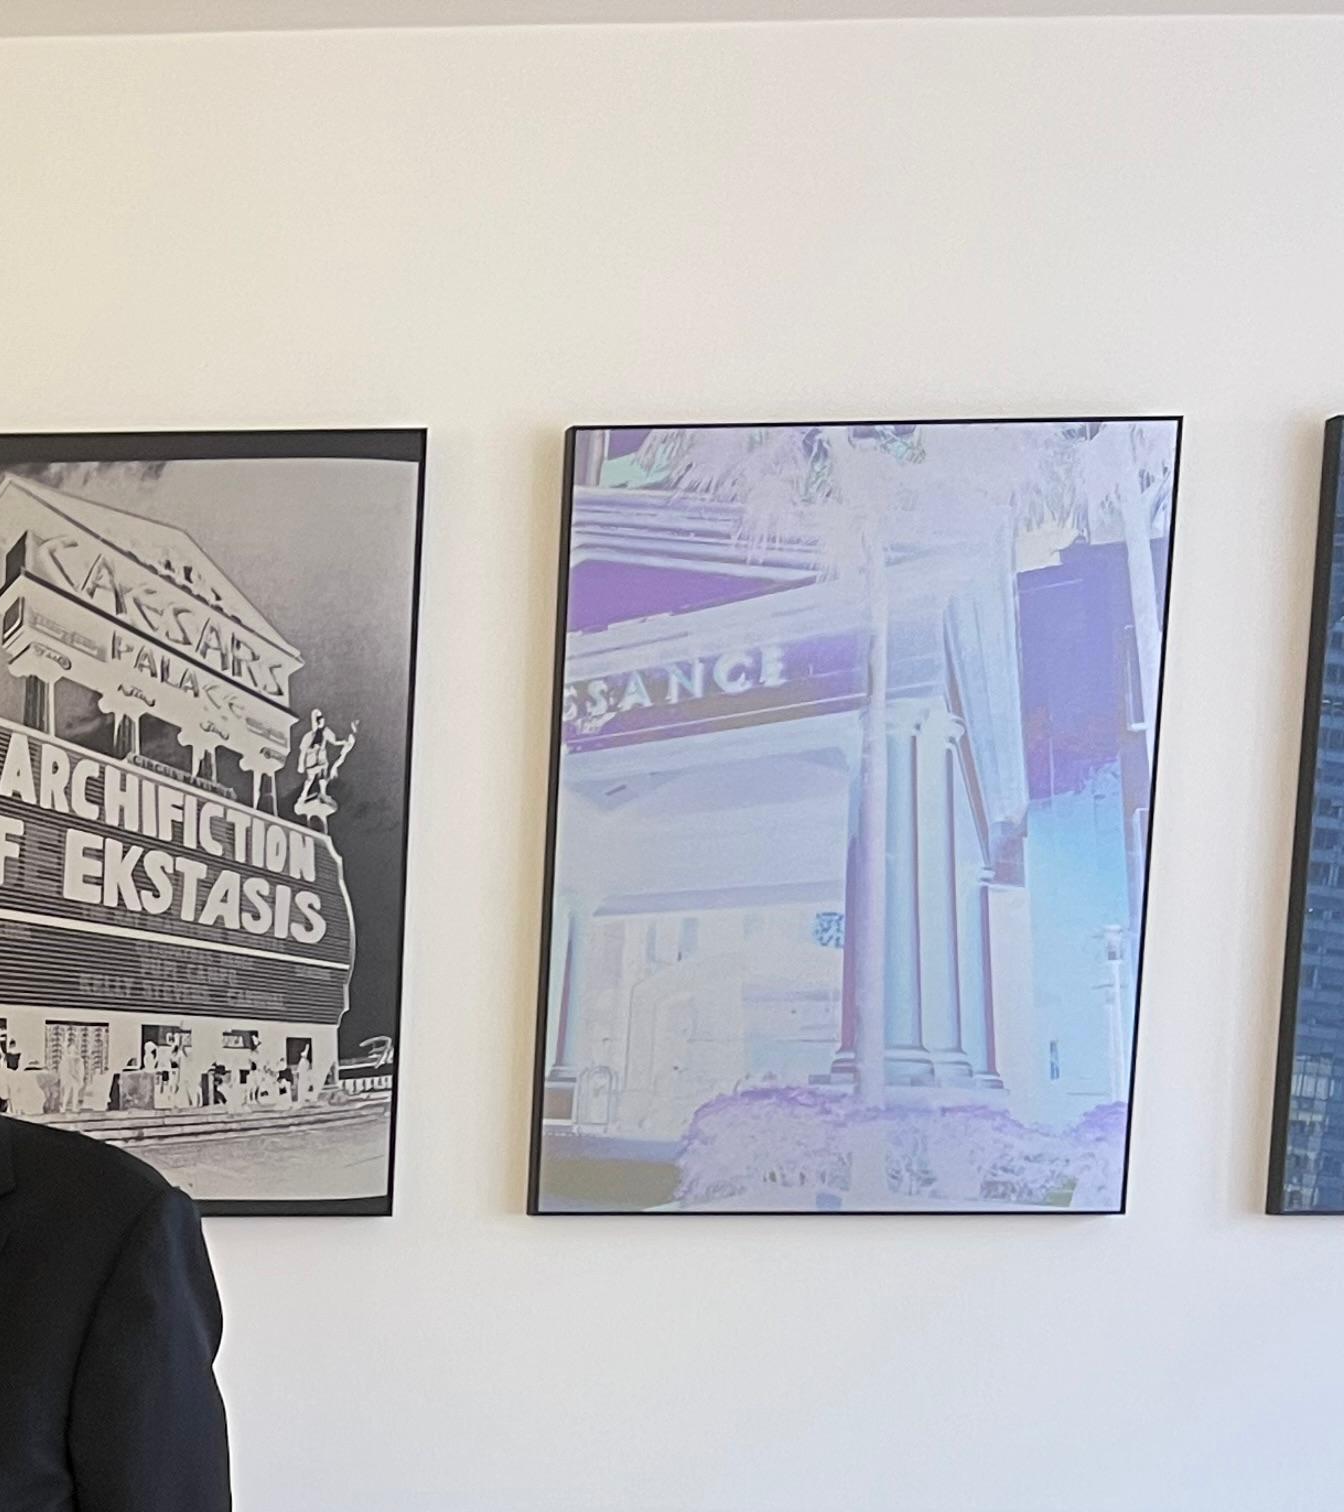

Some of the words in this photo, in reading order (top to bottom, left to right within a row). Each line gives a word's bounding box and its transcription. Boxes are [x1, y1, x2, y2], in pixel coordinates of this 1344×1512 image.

[35, 534, 284, 697] CAESARS
[111, 630, 246, 722] PALACE
[63, 828, 327, 944] EKSTASIS
